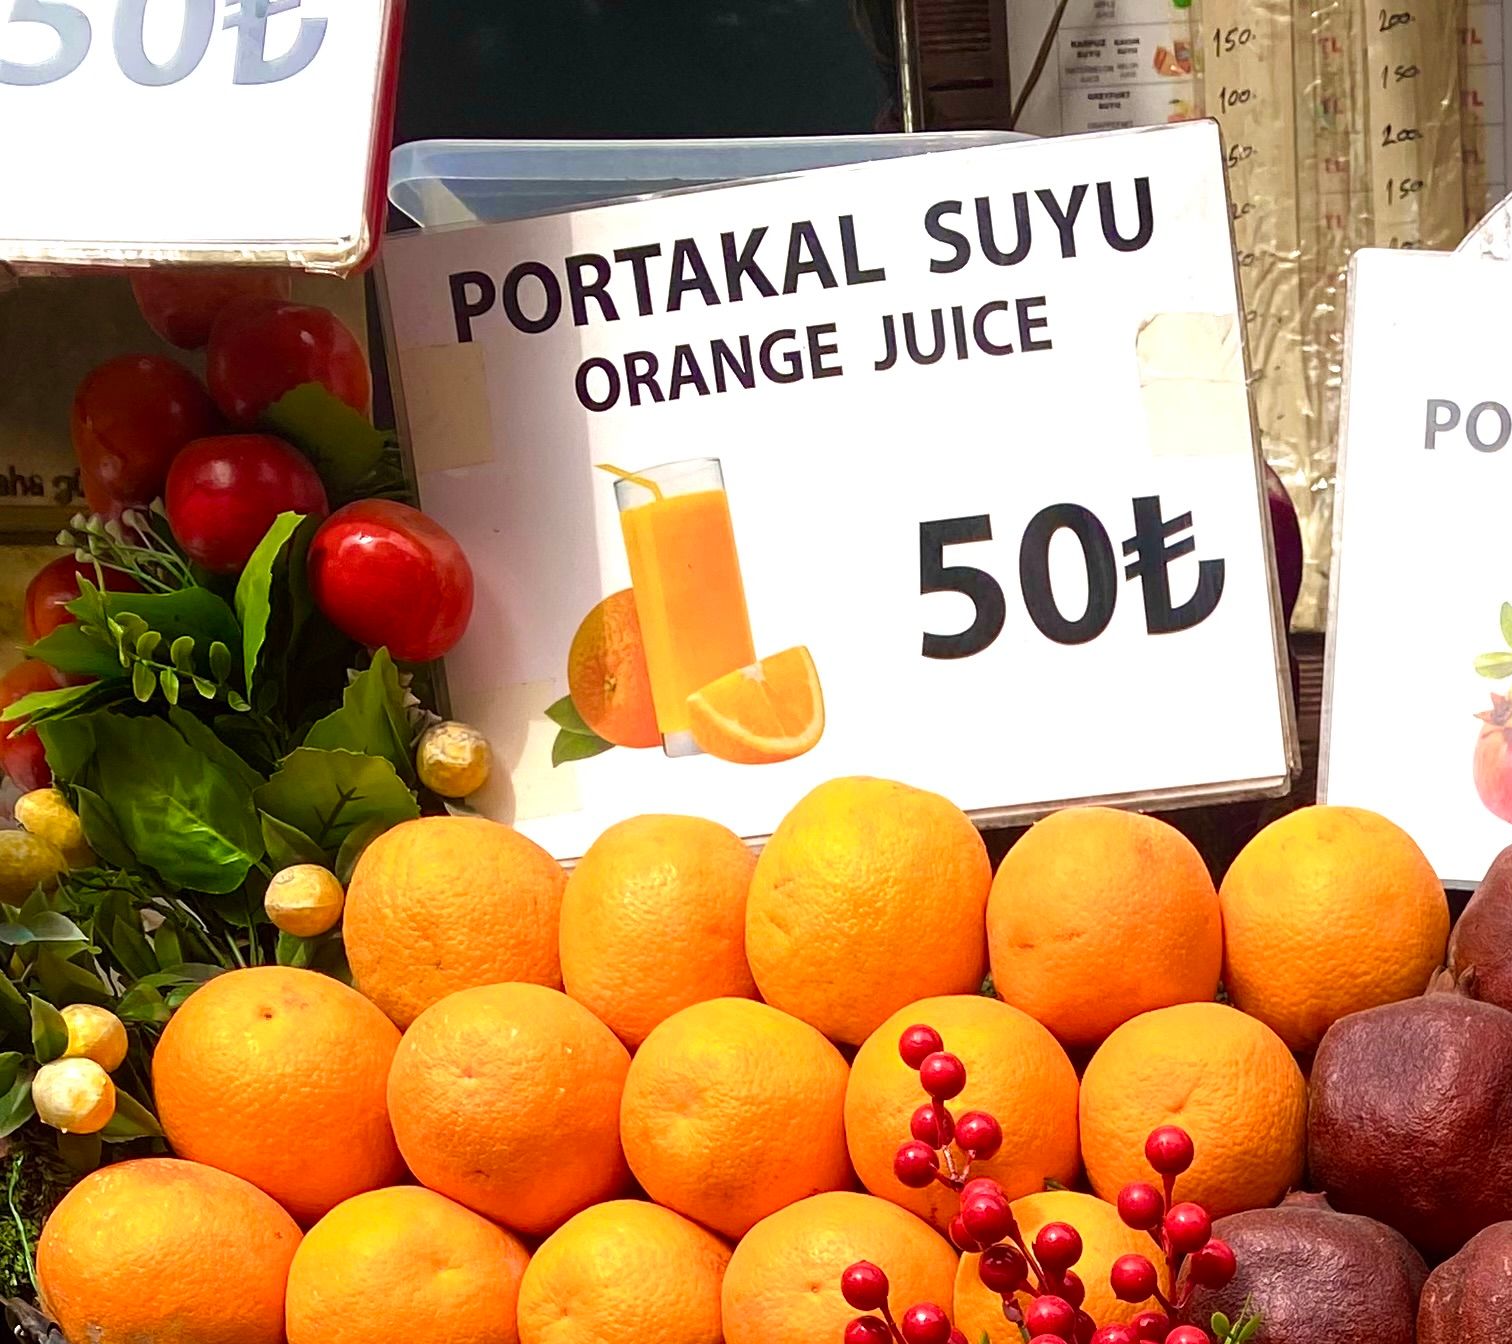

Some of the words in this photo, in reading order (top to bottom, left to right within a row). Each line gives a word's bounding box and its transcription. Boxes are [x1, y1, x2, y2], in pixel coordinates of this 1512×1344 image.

[449, 215, 886, 342] PORTAKAL
[925, 177, 1153, 273] SUYU
[575, 323, 843, 412] ORANGE
[875, 296, 1052, 370] JUICE
[920, 496, 1225, 659] 50₺
